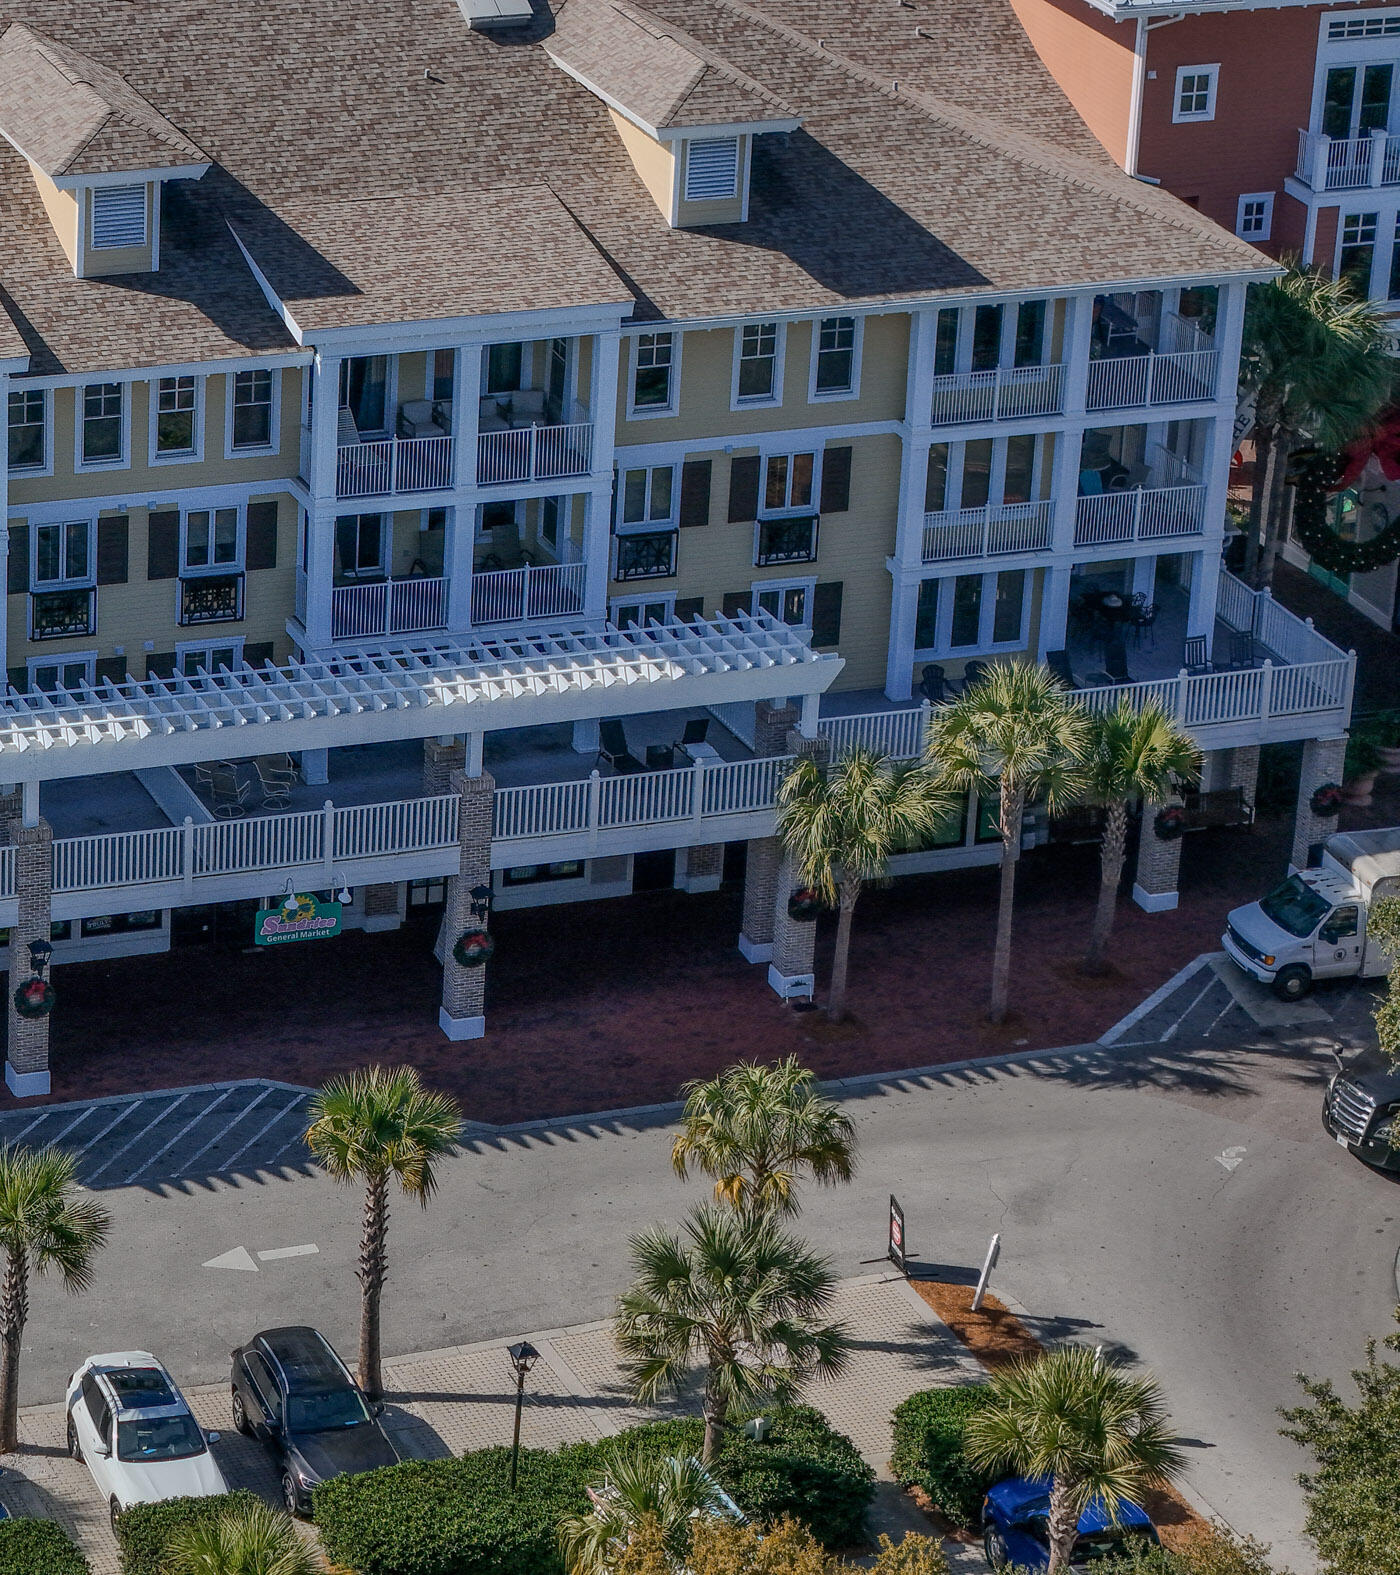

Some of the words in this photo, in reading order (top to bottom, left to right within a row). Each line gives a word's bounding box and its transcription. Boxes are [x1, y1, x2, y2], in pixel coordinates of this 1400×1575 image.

[260, 915, 337, 936] Sundries
[267, 931, 298, 943] General
[300, 929, 330, 939] Market
